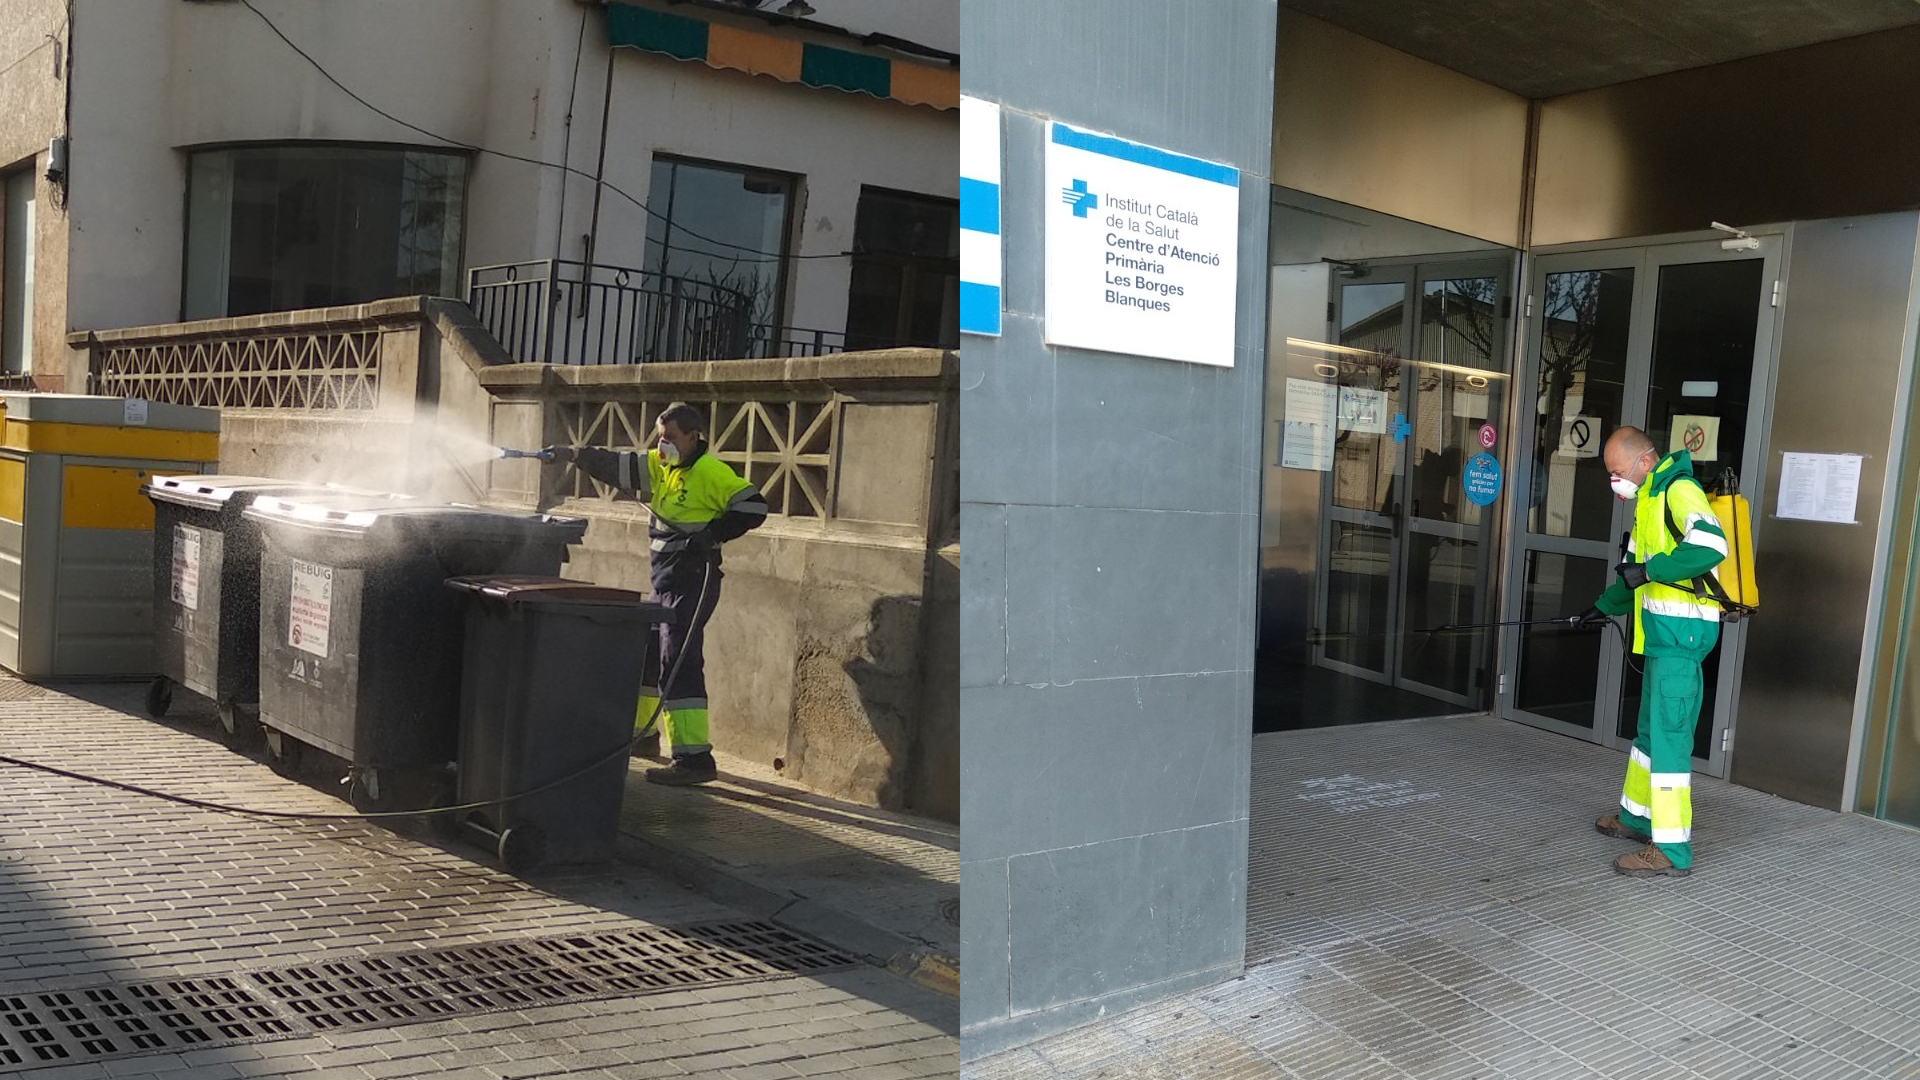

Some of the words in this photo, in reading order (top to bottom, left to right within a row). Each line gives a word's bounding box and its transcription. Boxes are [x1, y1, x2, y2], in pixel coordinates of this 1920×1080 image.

[1105, 193, 1152, 216] Institut
[1156, 204, 1199, 226] Català
[1105, 214, 1123, 229] de
[1128, 217, 1140, 232] la
[1145, 221, 1180, 240] Salut
[1105, 233, 1154, 254] Centre
[1158, 244, 1220, 267] d'Atenció
[1105, 251, 1165, 274] Primària
[1105, 270, 1131, 287] Les
[1135, 276, 1184, 296] Borges
[1105, 290, 1171, 312] Blanques
[1469, 470, 1482, 479] fem
[1483, 472, 1498, 481] salut
[1477, 485, 1496, 495] fumar
[293, 561, 331, 580] REBUIG
